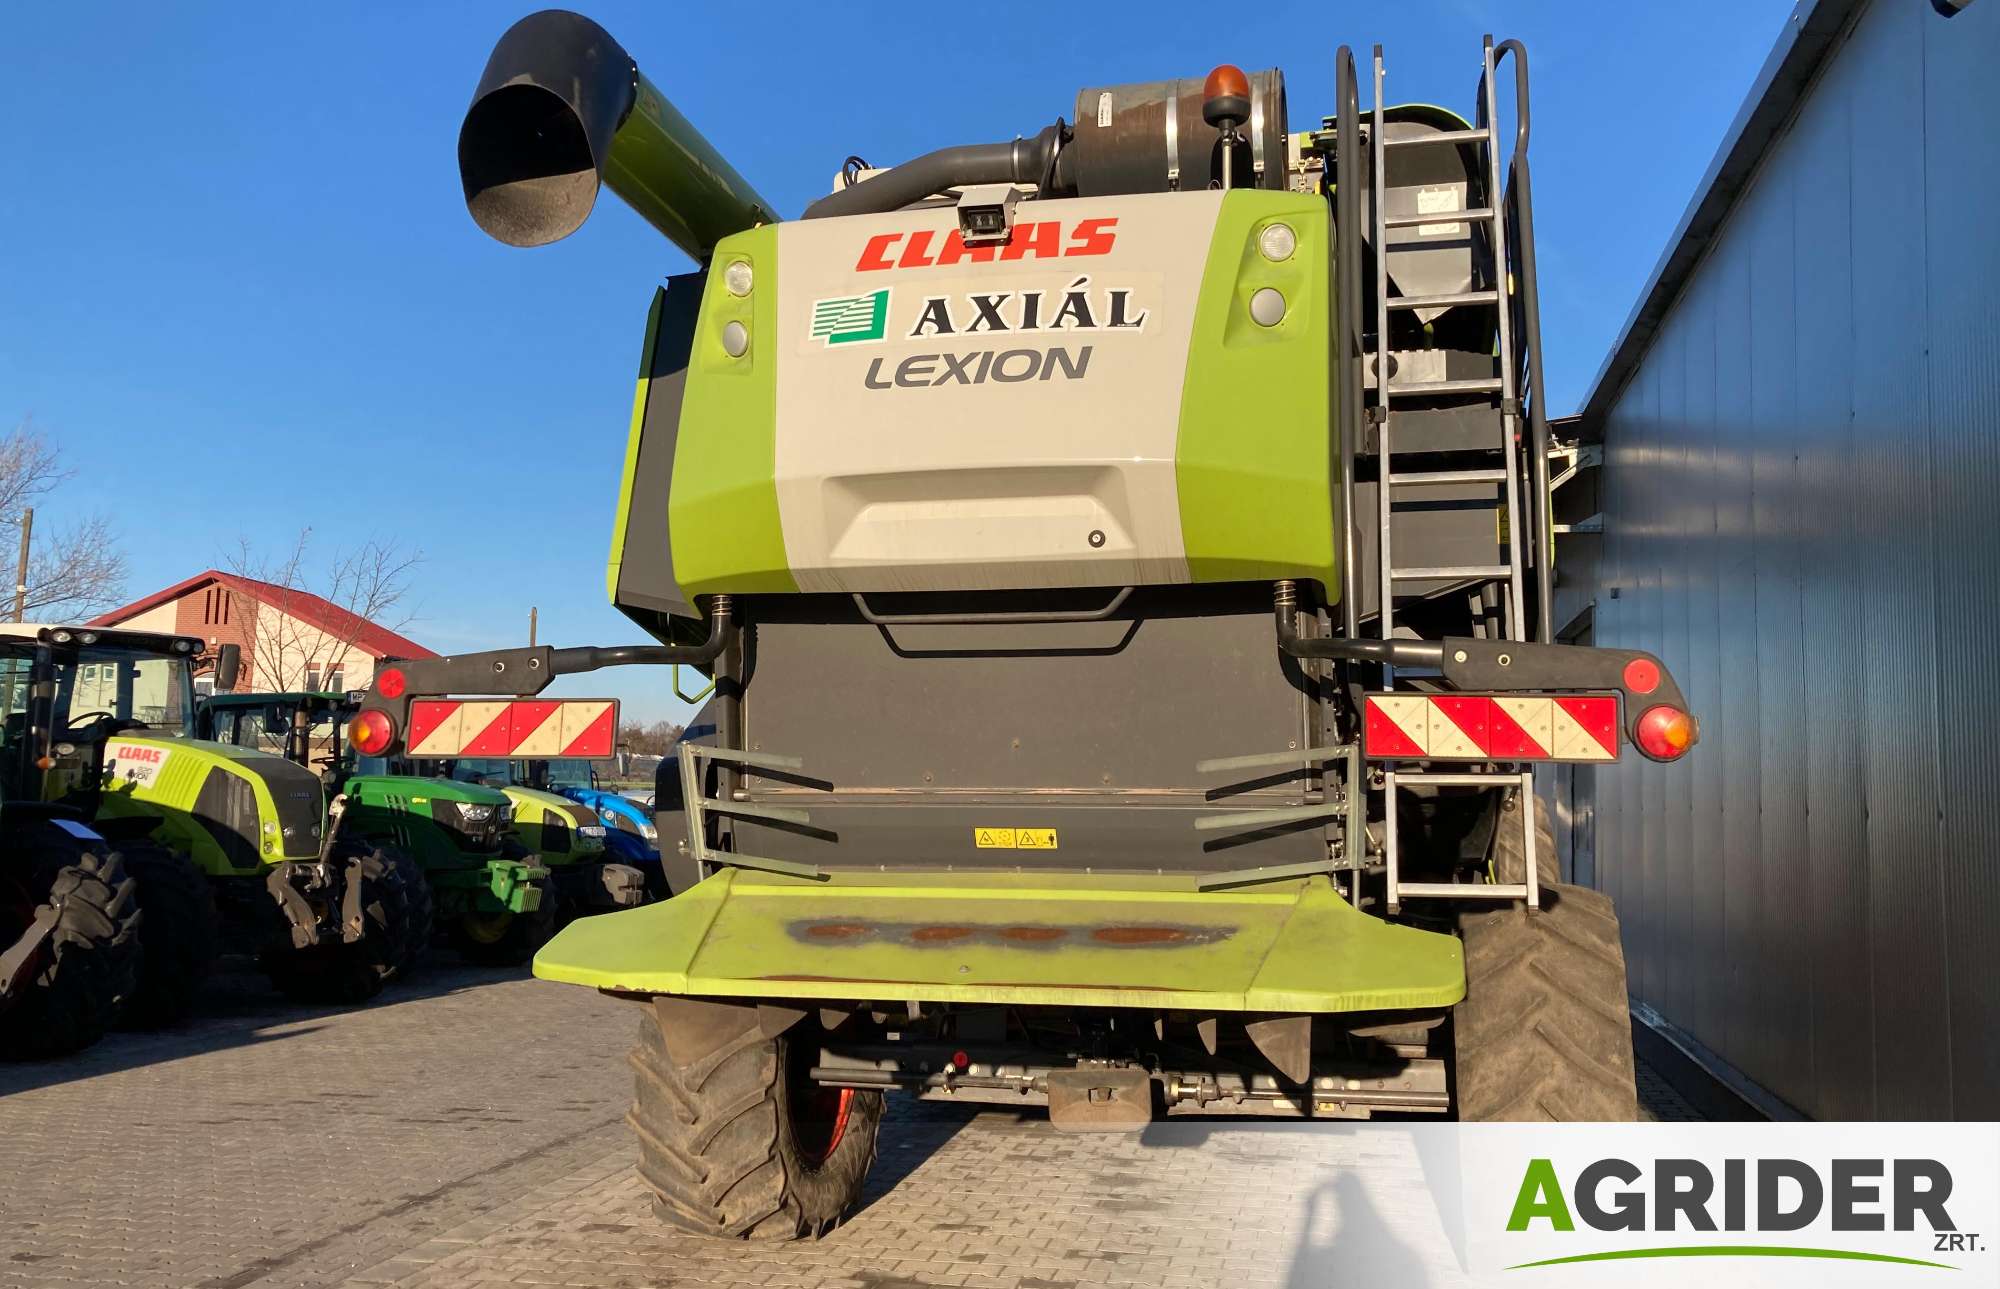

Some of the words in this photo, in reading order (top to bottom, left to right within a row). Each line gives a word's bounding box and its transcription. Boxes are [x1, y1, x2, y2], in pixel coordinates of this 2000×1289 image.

[909, 277, 1146, 336] AXIÁL
[864, 346, 1093, 389] LEXION
[118, 746, 162, 763] CLAAS
